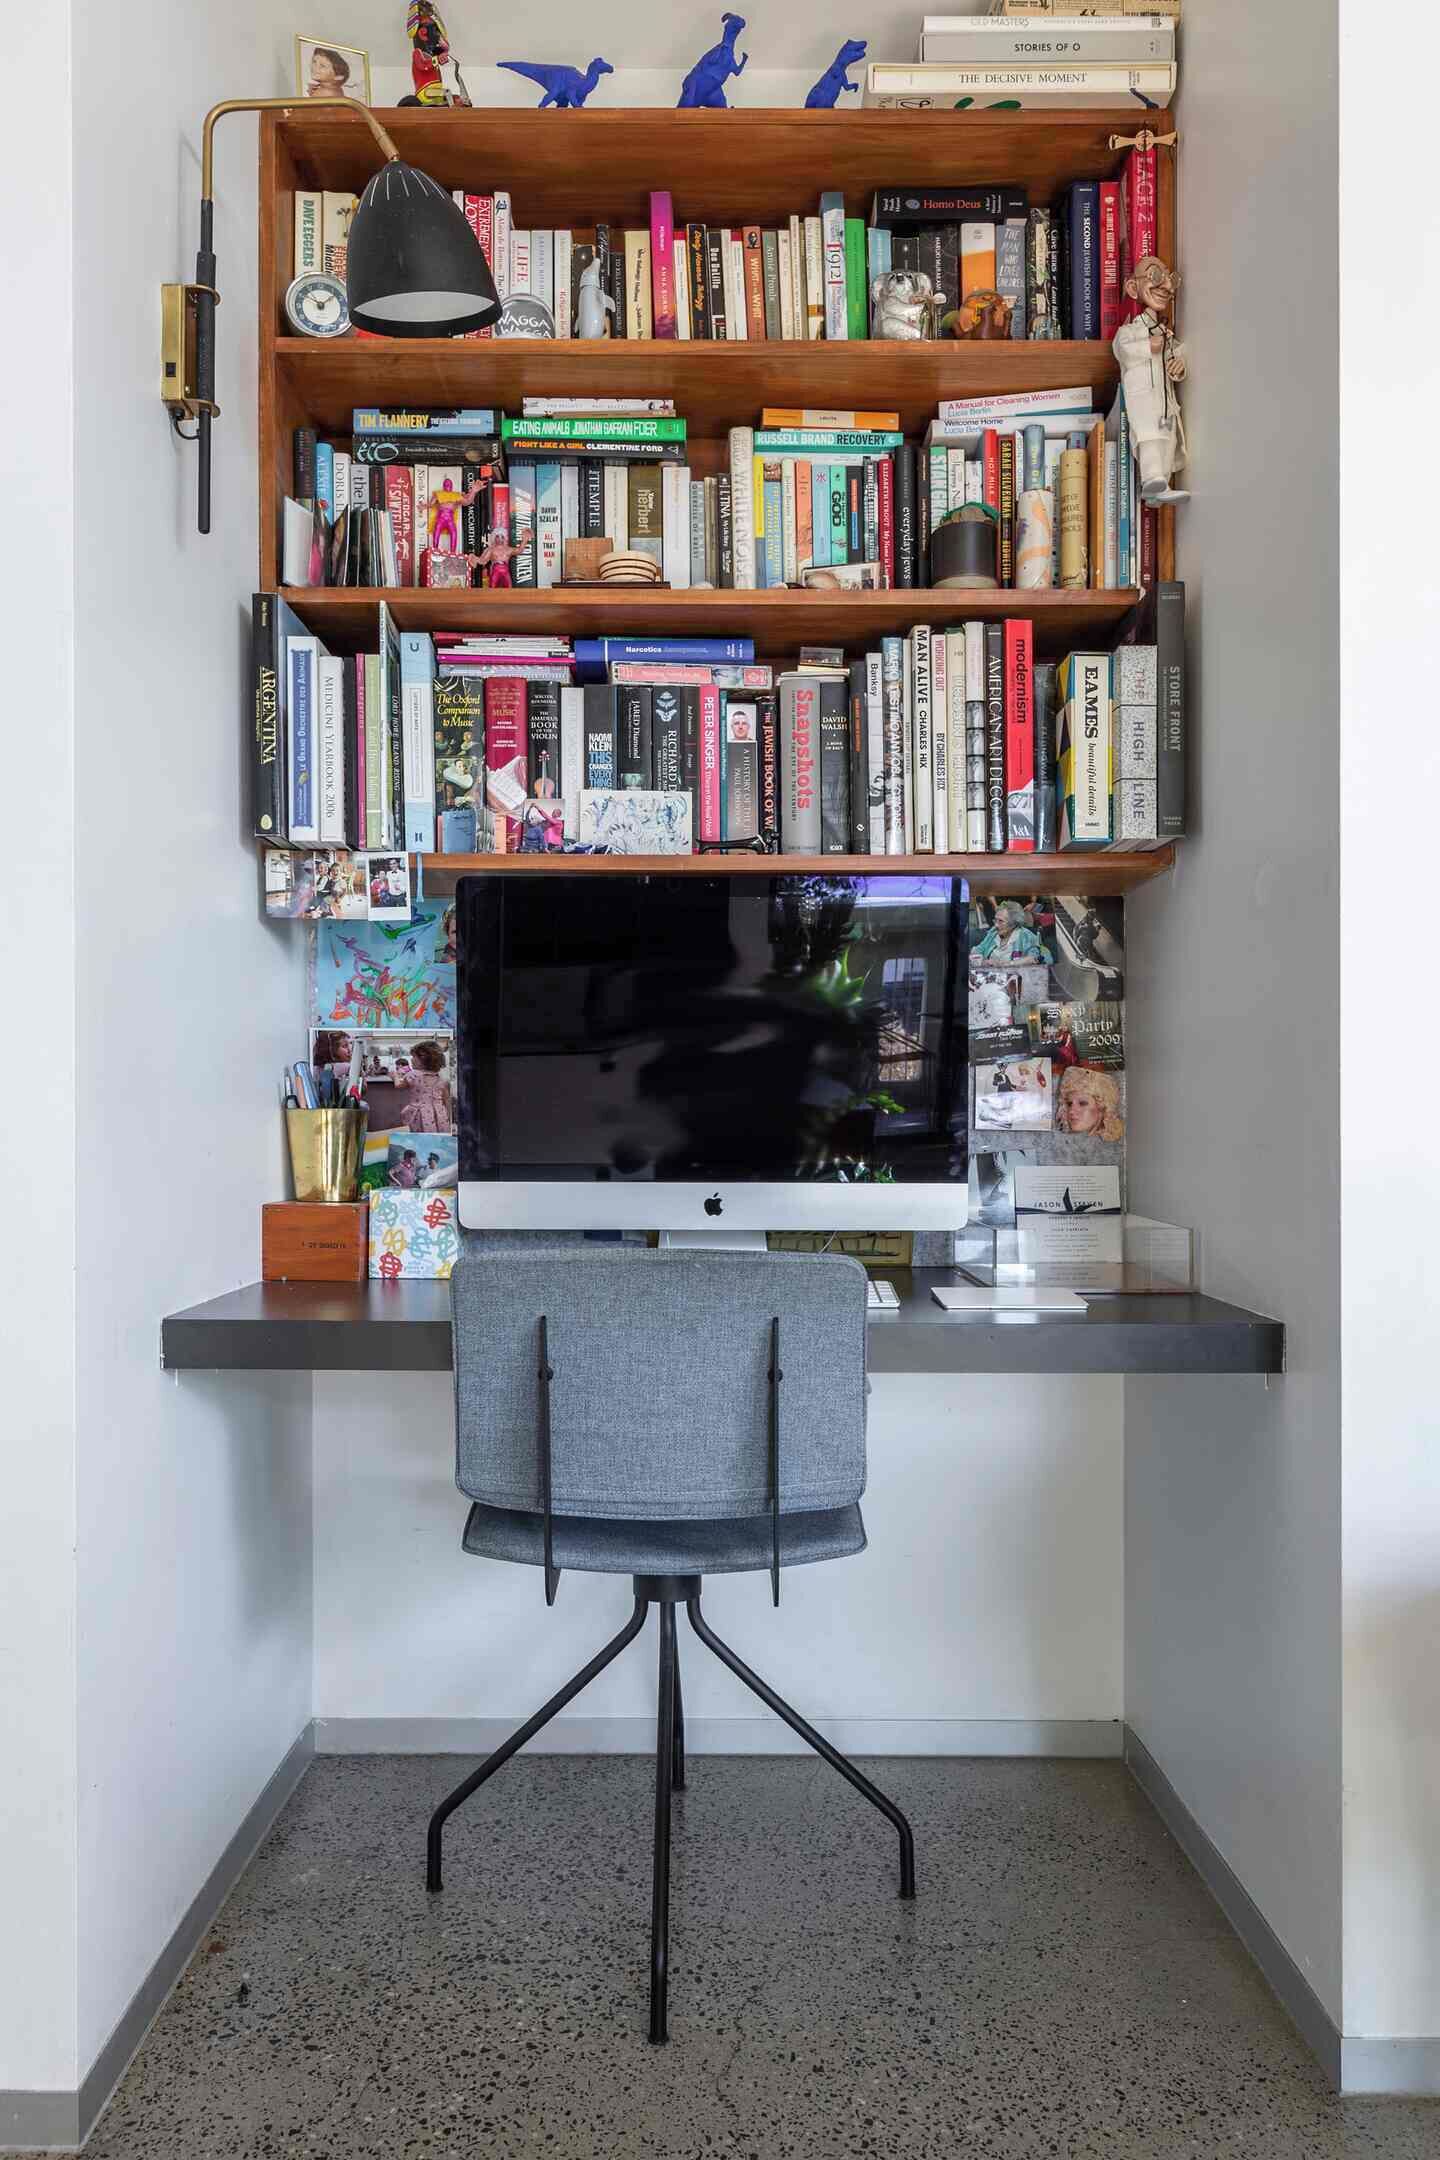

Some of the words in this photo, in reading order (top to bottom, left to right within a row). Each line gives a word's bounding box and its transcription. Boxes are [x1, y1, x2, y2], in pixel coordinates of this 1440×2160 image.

[990, 17, 1030, 27] MASTERS
[1014, 43, 1052, 52] STORIES
[1056, 43, 1069, 51] OF
[1072, 43, 1081, 51] O
[958, 73, 981, 84] THE
[984, 72, 1034, 84] DECISIVE
[1038, 72, 1088, 84] MOMENT
[1137, 156, 1152, 208] LACE
[303, 199, 316, 226] DAVE
[924, 199, 954, 209] Homo
[957, 199, 981, 209] Deus
[478, 199, 492, 252] EXTREMELY
[1083, 217, 1092, 248] SECOND
[1050, 229, 1059, 249] Clive
[517, 244, 529, 282] LIFE
[615, 258, 621, 268] TO
[751, 257, 760, 281] WHAT
[767, 246, 775, 271] Annie
[826, 249, 842, 279] 1912
[1083, 277, 1092, 301] BOOK
[752, 293, 762, 318] WHAT
[498, 311, 552, 330] WAGGA
[946, 408, 969, 417] Lucia
[948, 402, 955, 410] A
[955, 401, 983, 409] Manual
[983, 399, 996, 409] for
[996, 395, 1030, 407] Cleaning
[1031, 393, 1061, 401] Women
[358, 414, 378, 428] TIM
[379, 413, 430, 429] FLANNERY
[512, 420, 541, 437] EATING
[541, 421, 570, 436] ANIMALS
[943, 418, 979, 427] Welcome
[980, 416, 1005, 426] Home
[512, 441, 540, 449] FIGHT
[540, 441, 559, 450] LIKE
[559, 442, 567, 450] A
[567, 442, 586, 450] GIRL
[586, 443, 641, 452] CLEMENTINE
[758, 432, 799, 446] RUSSELL
[800, 433, 835, 446] BRAND
[836, 433, 888, 446] RECOVERY
[987, 457, 995, 475] HOT
[1001, 441, 1012, 469] SARAH
[335, 461, 345, 499] DORIS
[353, 475, 368, 498] the
[882, 463, 890, 500] ELIZABETH
[987, 476, 995, 495] MILK
[720, 494, 730, 519] TINA
[1002, 472, 1013, 519] SILVERMAN
[389, 489, 403, 536] SAWTELLE
[402, 493, 411, 536] EDGAR
[637, 488, 653, 534] herbert
[831, 490, 842, 528] GOD
[882, 529, 891, 540] My
[899, 506, 914, 556] everyday
[543, 542, 556, 550] THAT
[735, 528, 755, 584] NOISE
[901, 556, 914, 580] jews
[624, 646, 663, 654] Narcotics
[917, 628, 928, 662] MAN
[935, 639, 945, 675] WORKING
[889, 642, 901, 681] MARIO
[869, 663, 879, 697] Banksy
[917, 666, 928, 705] ALIVE
[936, 676, 945, 692] OUT
[1016, 638, 1029, 724] modernism
[1135, 669, 1145, 700] THE
[1169, 665, 1182, 707] STORE
[324, 675, 335, 731] MEDICINE
[392, 694, 401, 716] LORD
[437, 693, 452, 705] The
[452, 693, 481, 707] Oxford
[989, 655, 1003, 735] AMERICAN
[1084, 666, 1099, 739] EAMES
[262, 666, 277, 765] ARGENTINA
[297, 699, 307, 737] ORCHESTRE
[436, 704, 481, 718] Companion
[449, 716, 474, 727] Music
[632, 700, 642, 726] JARED
[704, 695, 715, 729] PETER
[367, 725, 378, 745] Lord
[392, 716, 401, 738] HOWE
[588, 733, 613, 742] NAOMI
[919, 710, 928, 751] CHARLES
[936, 732, 945, 743] BY
[1169, 711, 1182, 752] FRONT
[297, 738, 307, 762] GRAND
[392, 739, 402, 766] ISLAND
[588, 742, 613, 752] KLEIN
[633, 727, 642, 759] Diamond
[705, 729, 716, 770] SINGER
[764, 725, 775, 762] JEWISH
[792, 688, 816, 810] Snapshots
[890, 733, 901, 757] ANY
[989, 736, 1003, 762] ART
[1133, 720, 1145, 762] HIGH
[324, 733, 336, 791] YEARBOOK
[588, 751, 613, 763] THIS
[668, 730, 678, 782] RICHARD
[919, 752, 928, 769] HIX
[936, 743, 945, 777] CHARLES
[1087, 742, 1097, 784] beautiful
[392, 767, 402, 792] RISING
[588, 769, 614, 779] EVERY
[588, 778, 614, 788] THING
[734, 767, 742, 786] PAUL
[743, 756, 752, 793] HISTORY
[764, 764, 775, 796] BOOK
[791, 769, 797, 778] OF
[937, 777, 946, 791] HIX
[367, 775, 379, 801] Island
[744, 793, 752, 803] OF
[989, 765, 1003, 810] DECO
[1087, 785, 1097, 816] details
[325, 793, 336, 819] 2006
[764, 798, 775, 815] OF
[1133, 783, 1146, 820] LINE
[1071, 1020, 1114, 1037] Party
[1033, 1200, 1062, 1209] JASON
